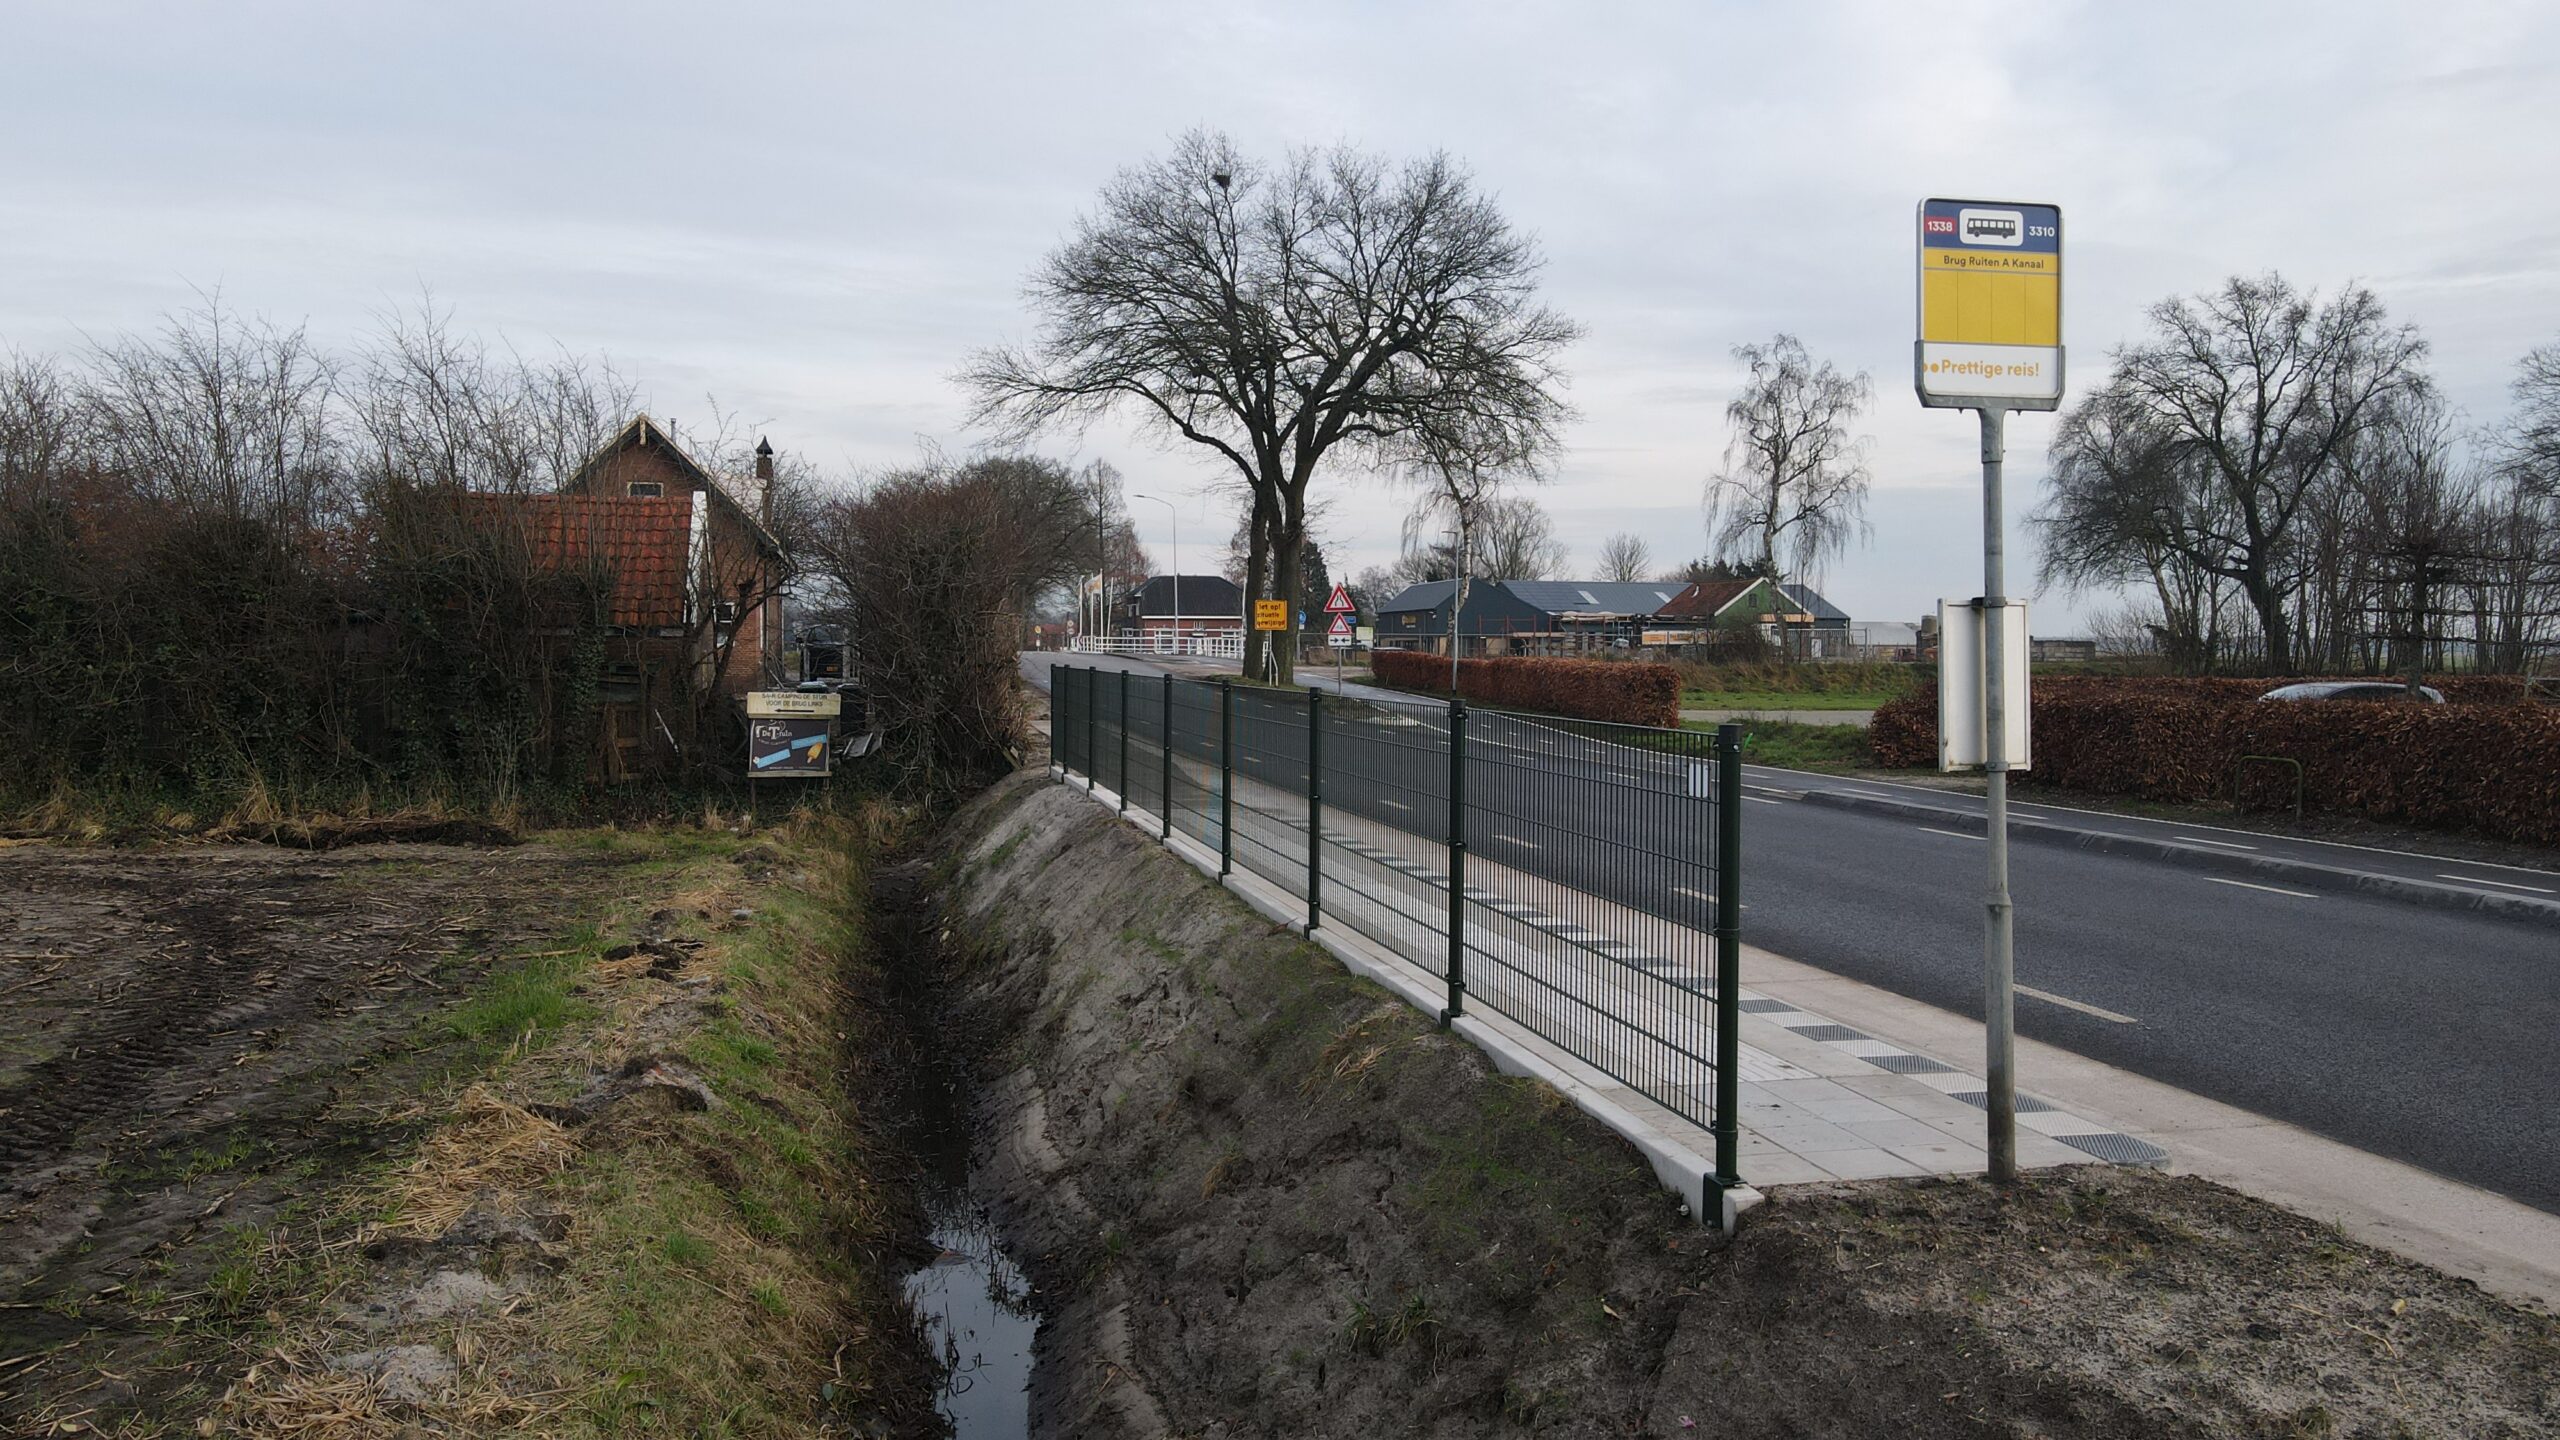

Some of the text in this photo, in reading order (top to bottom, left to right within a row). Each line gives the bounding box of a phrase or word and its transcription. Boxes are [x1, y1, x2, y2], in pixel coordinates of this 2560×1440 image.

[1927, 220, 1953, 232] 1338
[2029, 225, 2055, 238] 3310
[1943, 255, 2044, 269] Brug Ruiten A Kanaal
[1941, 359, 2040, 379] Prettige reis!
